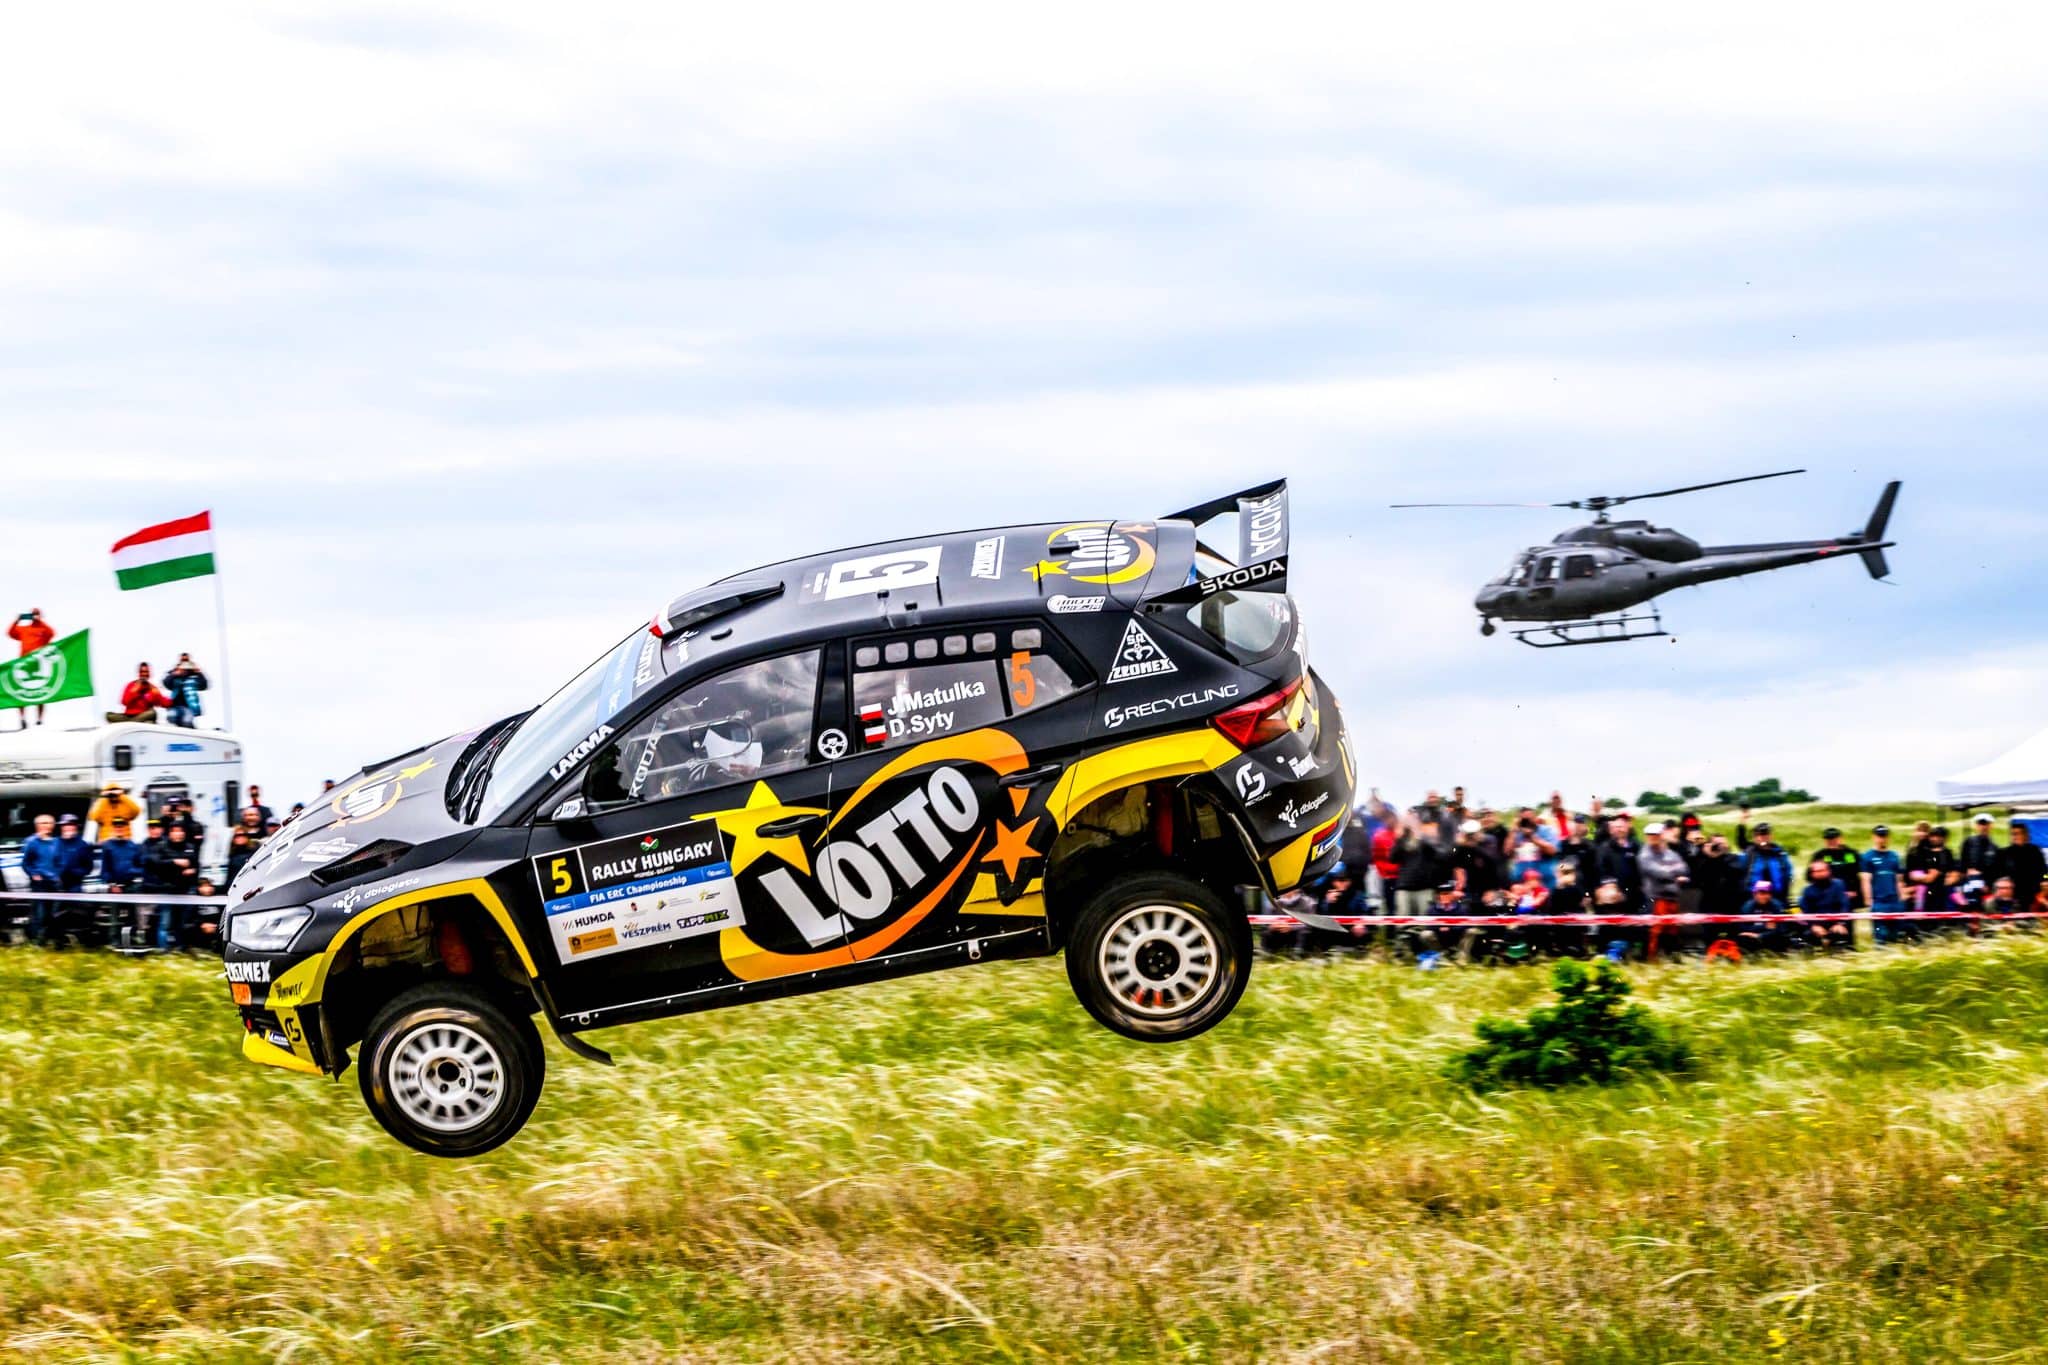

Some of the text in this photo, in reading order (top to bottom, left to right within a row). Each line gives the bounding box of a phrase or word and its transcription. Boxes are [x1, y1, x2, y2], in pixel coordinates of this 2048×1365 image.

[1011, 651, 1036, 707] 5
[1124, 684, 1239, 720] RECYCLING
[889, 710, 955, 737] D.Syty
[549, 724, 616, 781] LAKMA
[592, 857, 638, 881] RALLY
[641, 841, 713, 870] HUNGARY
[757, 766, 979, 948] LOTTO
[551, 858, 573, 894] 5
[590, 875, 688, 904] FIA ERC Championship
[575, 911, 615, 928] HUMDA
[622, 921, 671, 939] VESZPRÉM
